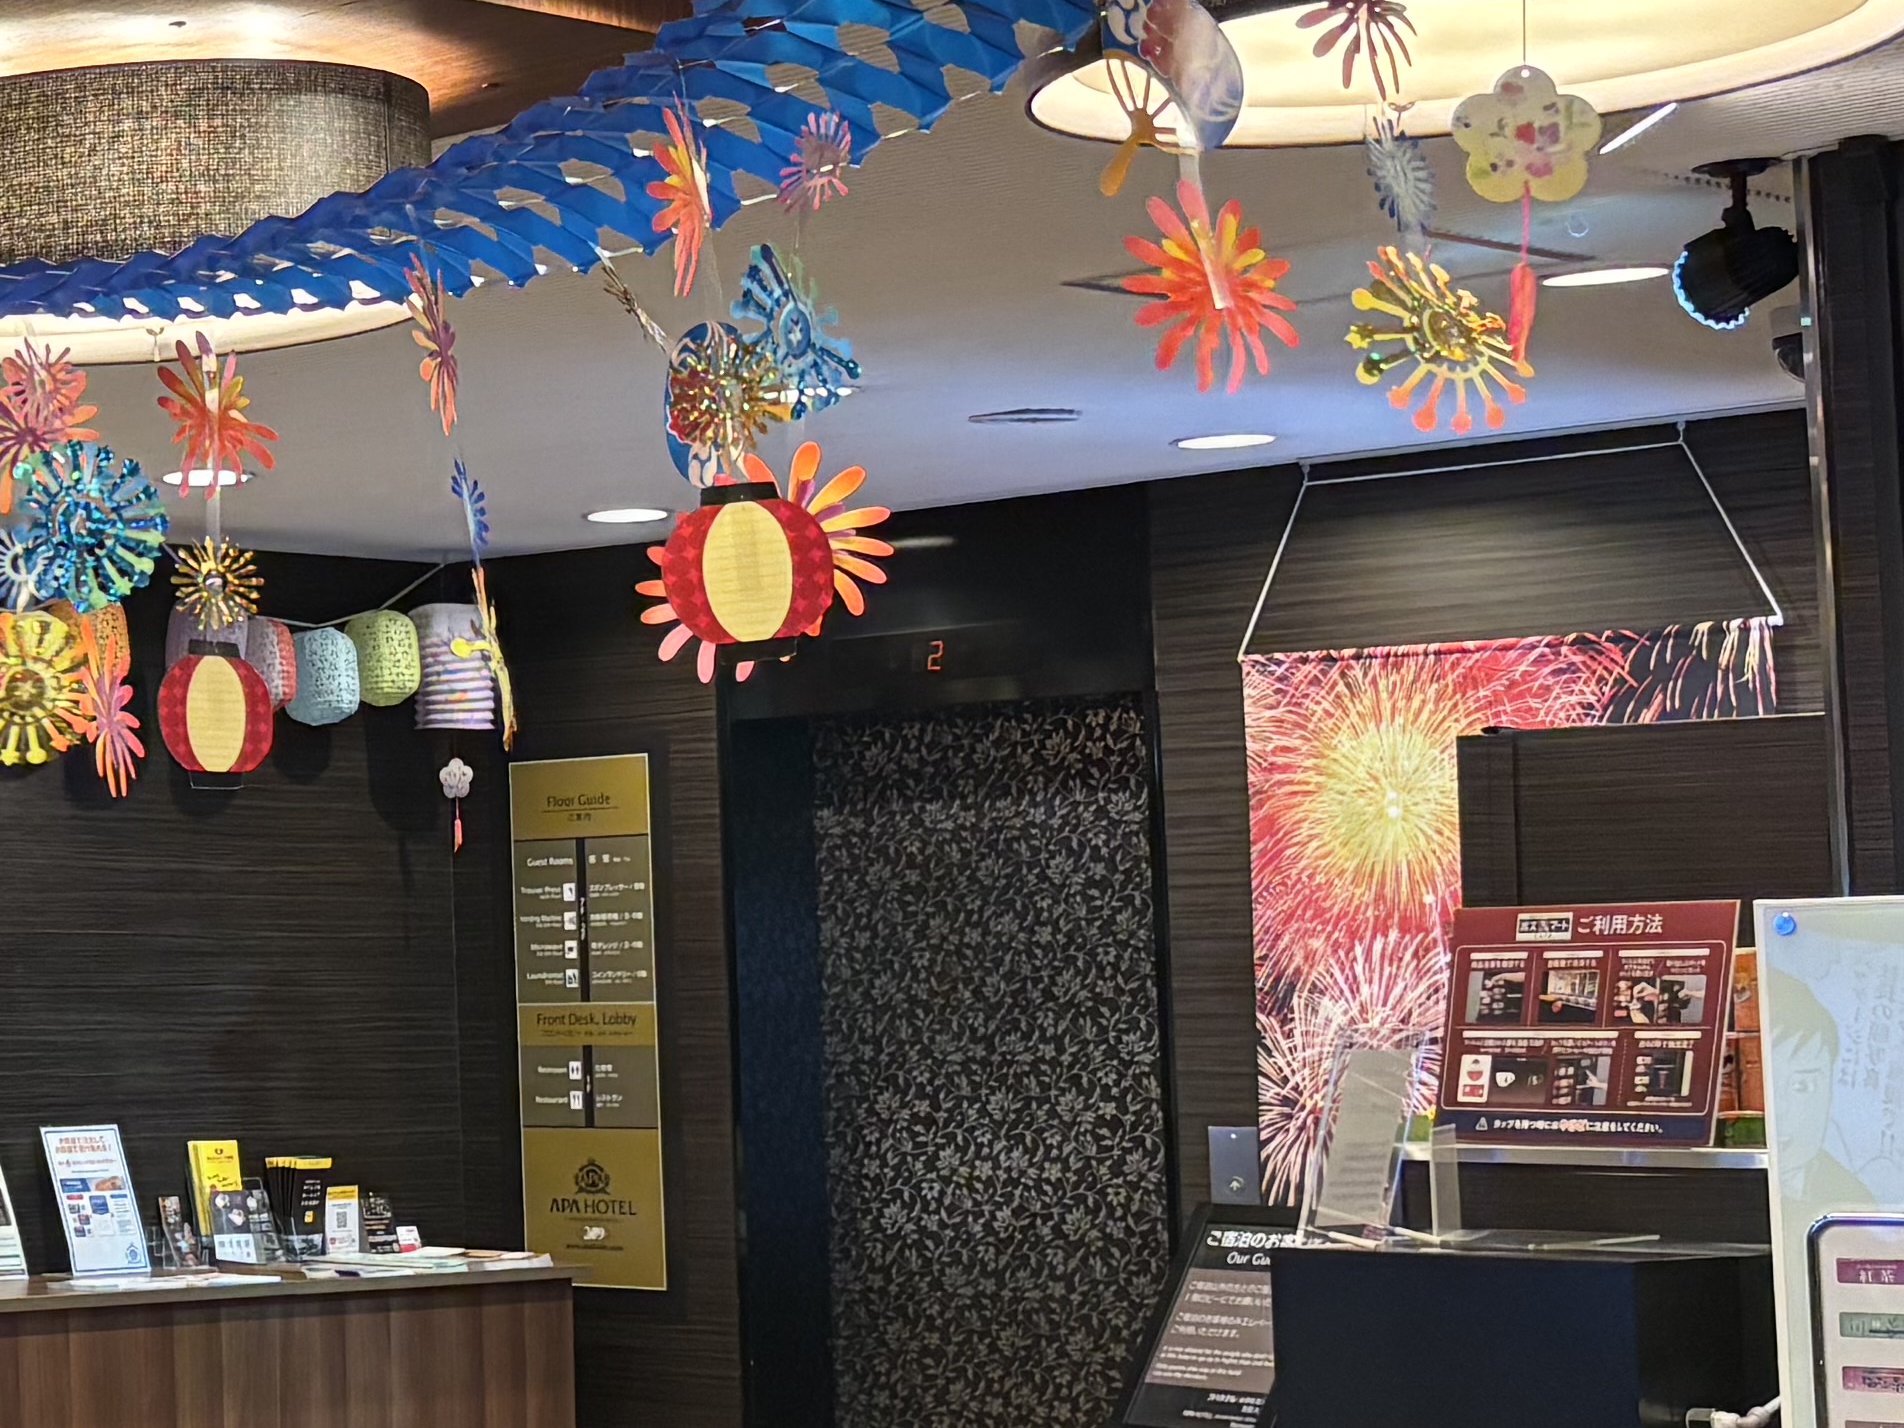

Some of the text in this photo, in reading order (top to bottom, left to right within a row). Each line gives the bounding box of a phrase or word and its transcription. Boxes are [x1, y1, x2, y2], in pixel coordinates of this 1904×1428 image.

[928, 641, 943, 670] 2
[547, 792, 611, 807] Floor Guide
[1577, 914, 1663, 935] ご利用方法
[537, 1013, 565, 1025] Front
[602, 1012, 637, 1026] Lobby
[550, 1198, 637, 1215] APA HOTEL
[1227, 1251, 1248, 1264] Our
